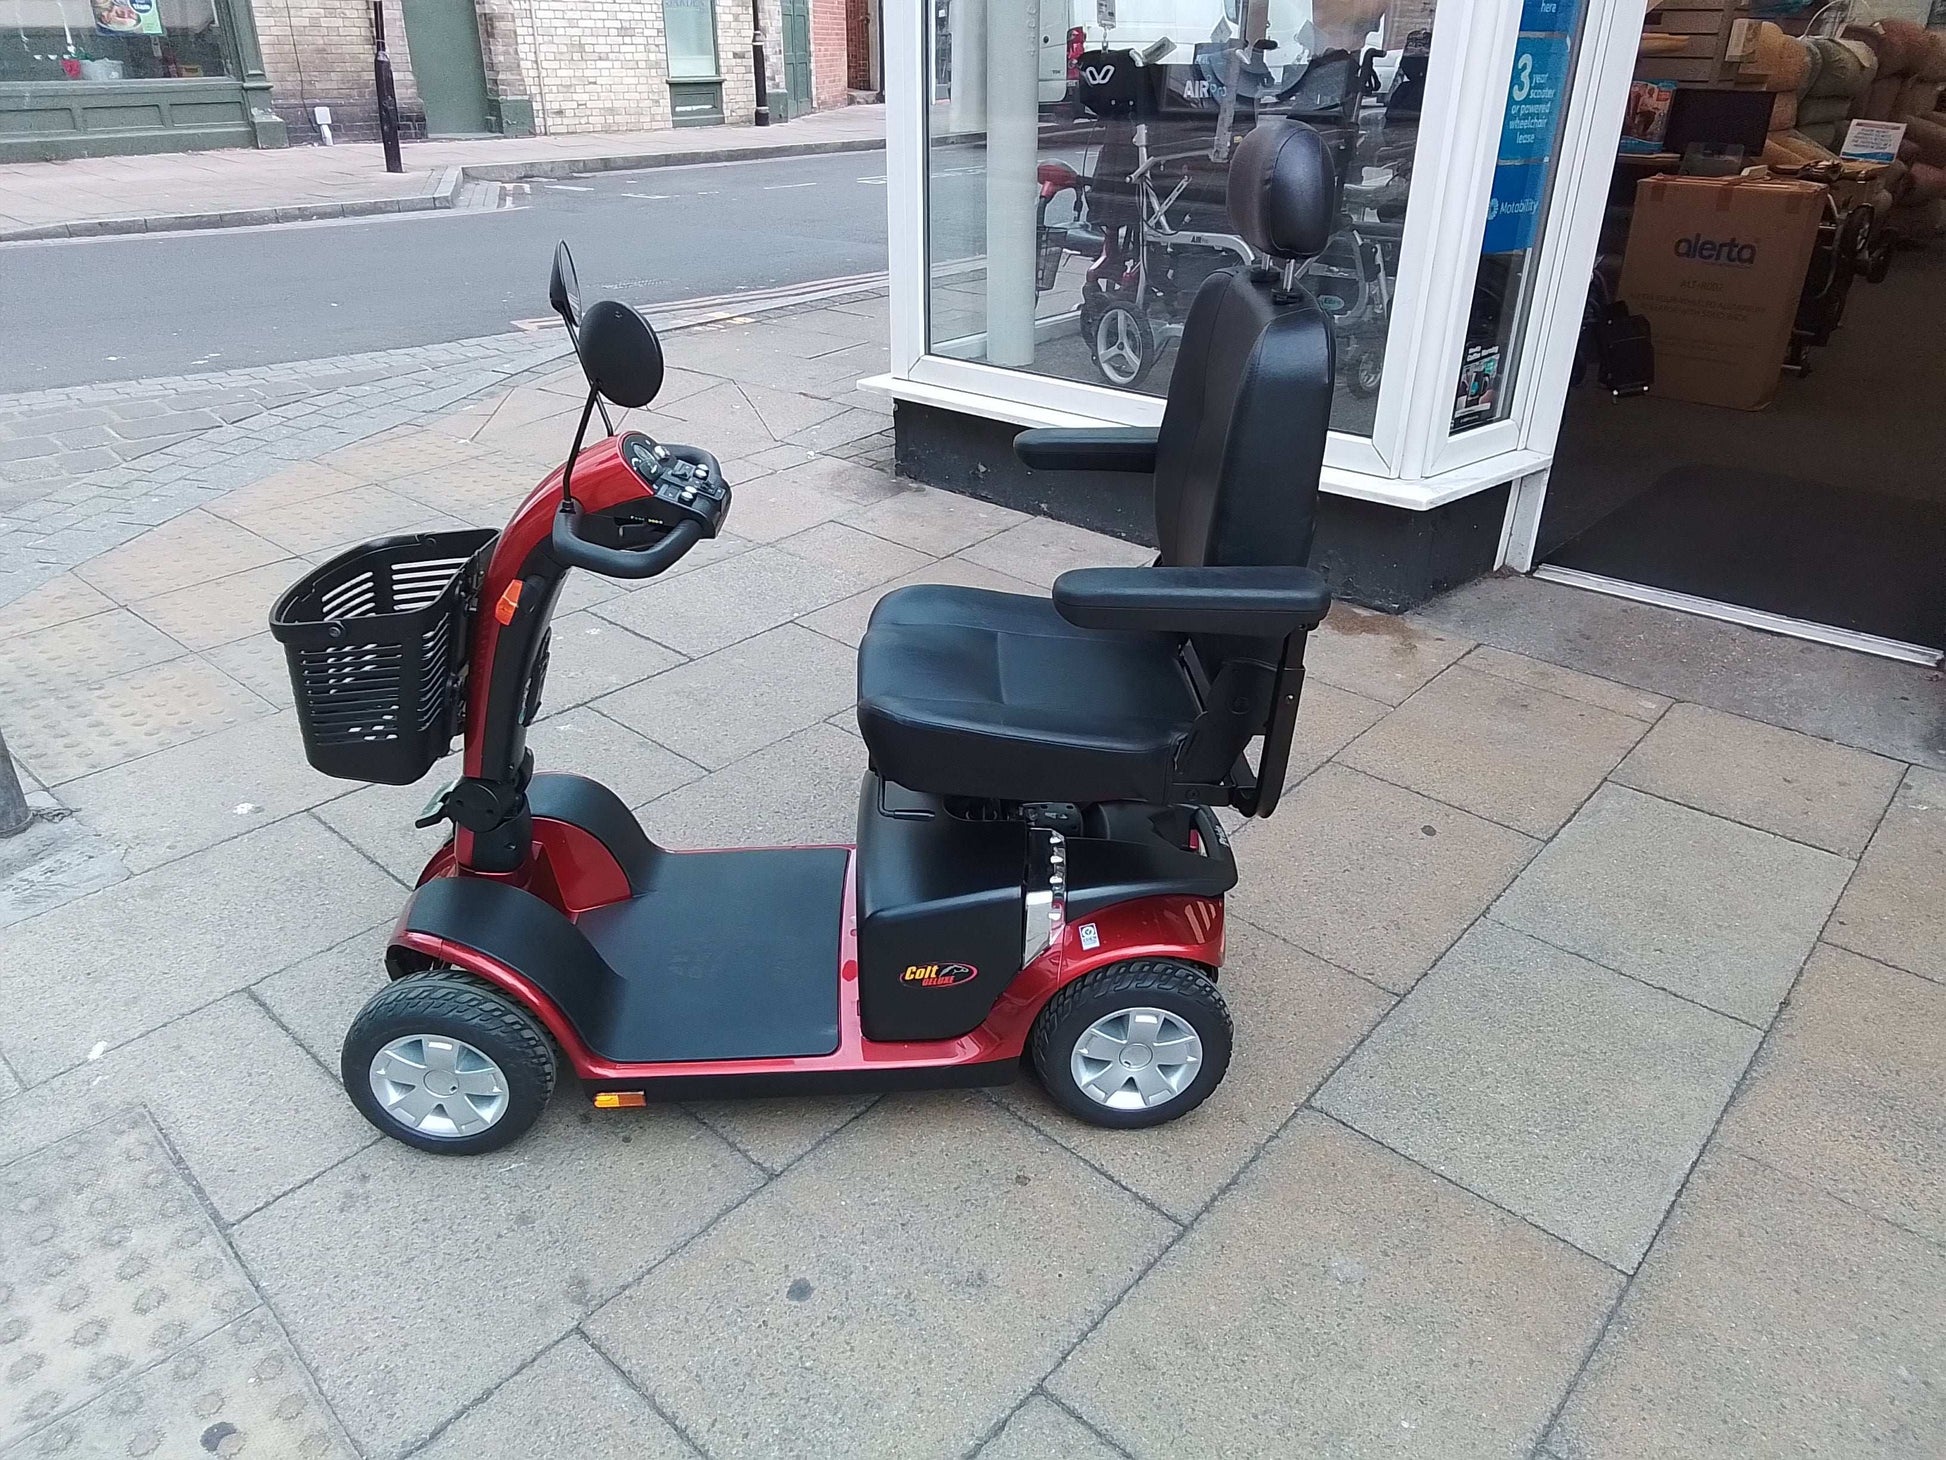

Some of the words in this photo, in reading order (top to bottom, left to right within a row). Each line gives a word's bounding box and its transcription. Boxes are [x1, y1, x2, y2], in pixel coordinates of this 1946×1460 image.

[1540, 2, 1556, 13] here
[1513, 53, 1533, 101] 3
[1531, 73, 1549, 87] year
[1529, 88, 1556, 99] scooter
[1511, 104, 1521, 114] or
[1520, 101, 1551, 116] powered
[1509, 116, 1548, 130] wheelchair
[1516, 132, 1535, 144] lease
[1500, 199, 1539, 215] Motability
[1674, 232, 1757, 265] alerta
[904, 965, 939, 980] Colt
[922, 976, 955, 986] DELUXE
